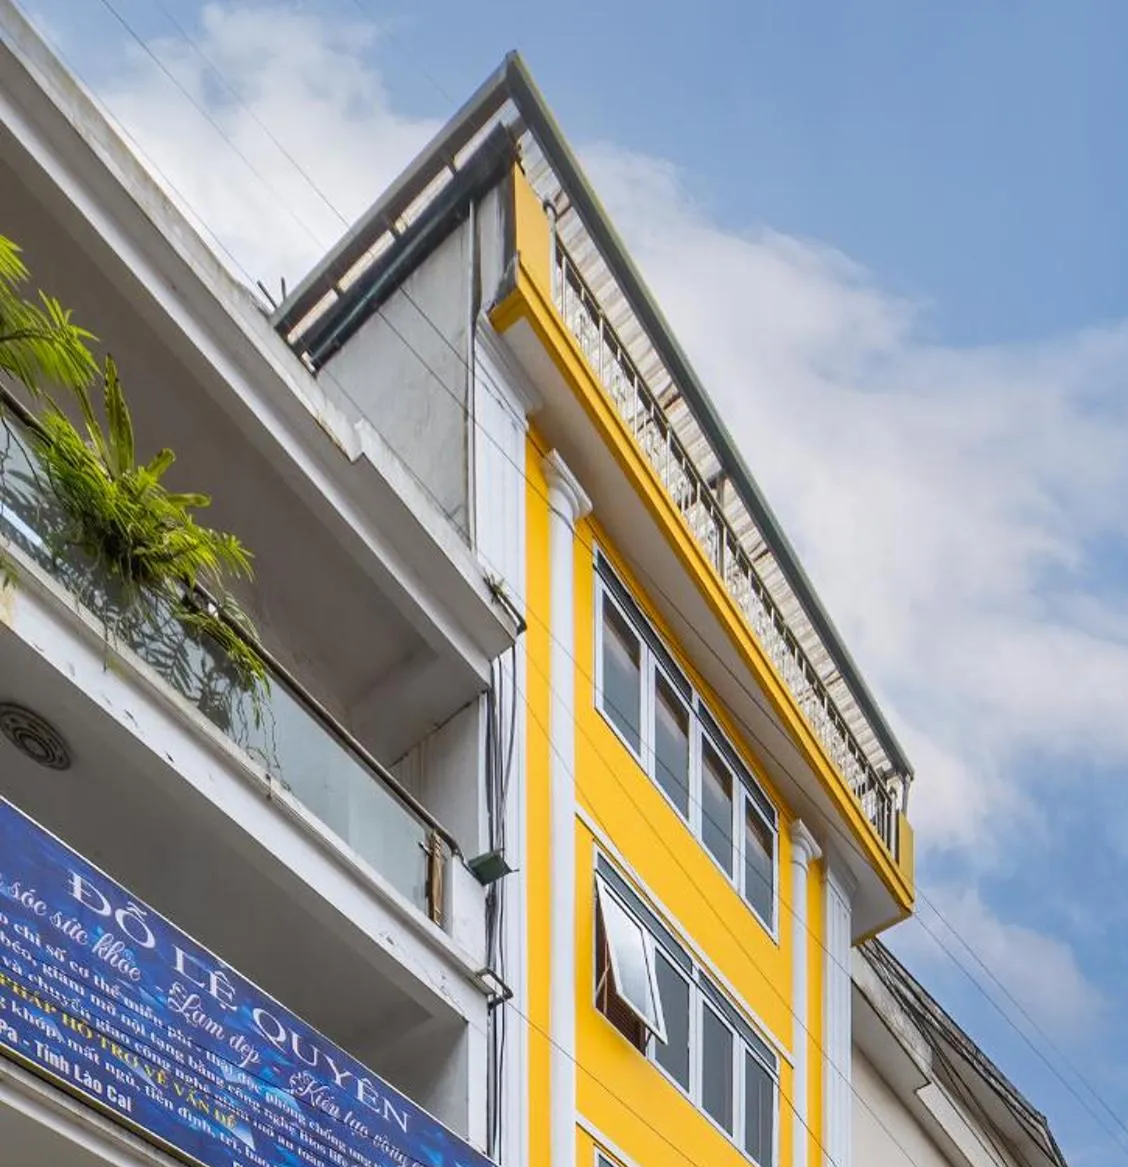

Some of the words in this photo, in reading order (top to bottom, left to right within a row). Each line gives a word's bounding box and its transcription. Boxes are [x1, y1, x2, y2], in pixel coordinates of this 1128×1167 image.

[68, 868, 156, 949] ĐỖ
[171, 944, 238, 1012] LỆ
[73, 1064, 103, 1094] Lào
[106, 1084, 132, 1112] Cai
